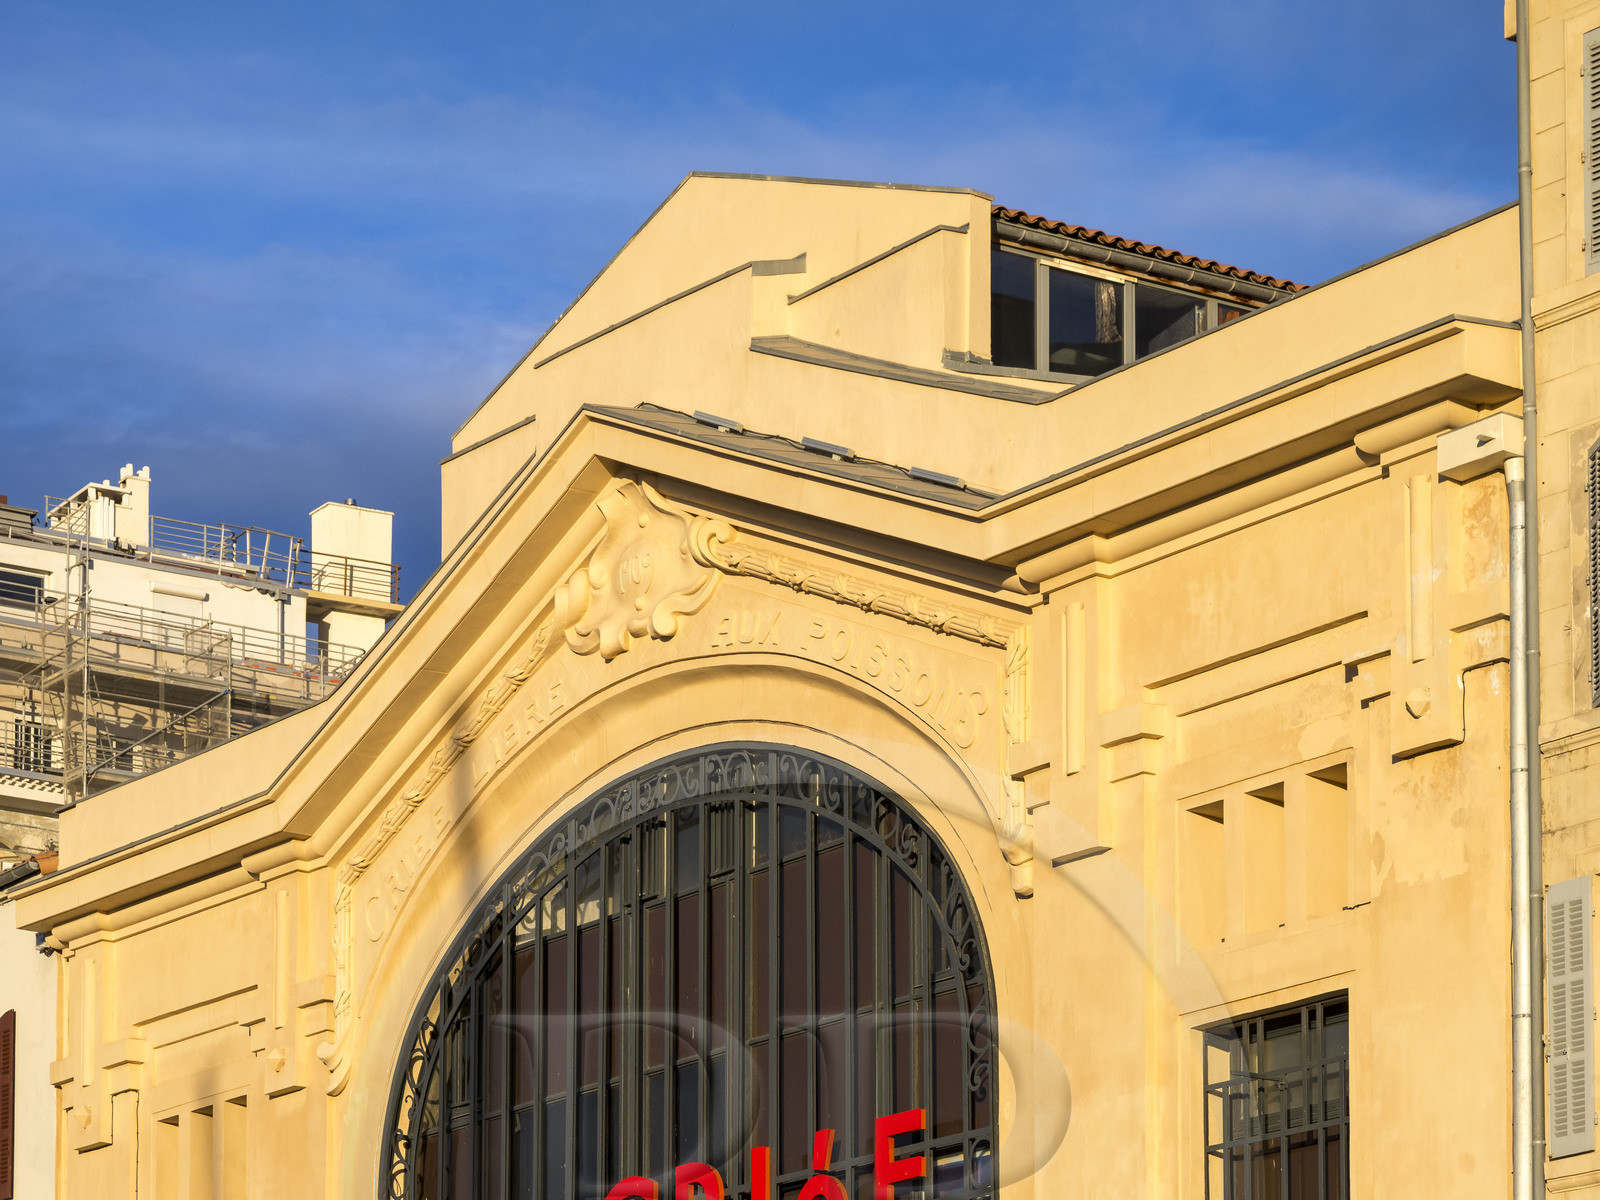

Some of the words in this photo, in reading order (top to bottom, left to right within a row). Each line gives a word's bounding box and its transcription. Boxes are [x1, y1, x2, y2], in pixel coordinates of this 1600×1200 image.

[471, 682, 567, 789] LIBRE
[711, 610, 782, 648] AUX
[800, 617, 990, 749] POISSONS
